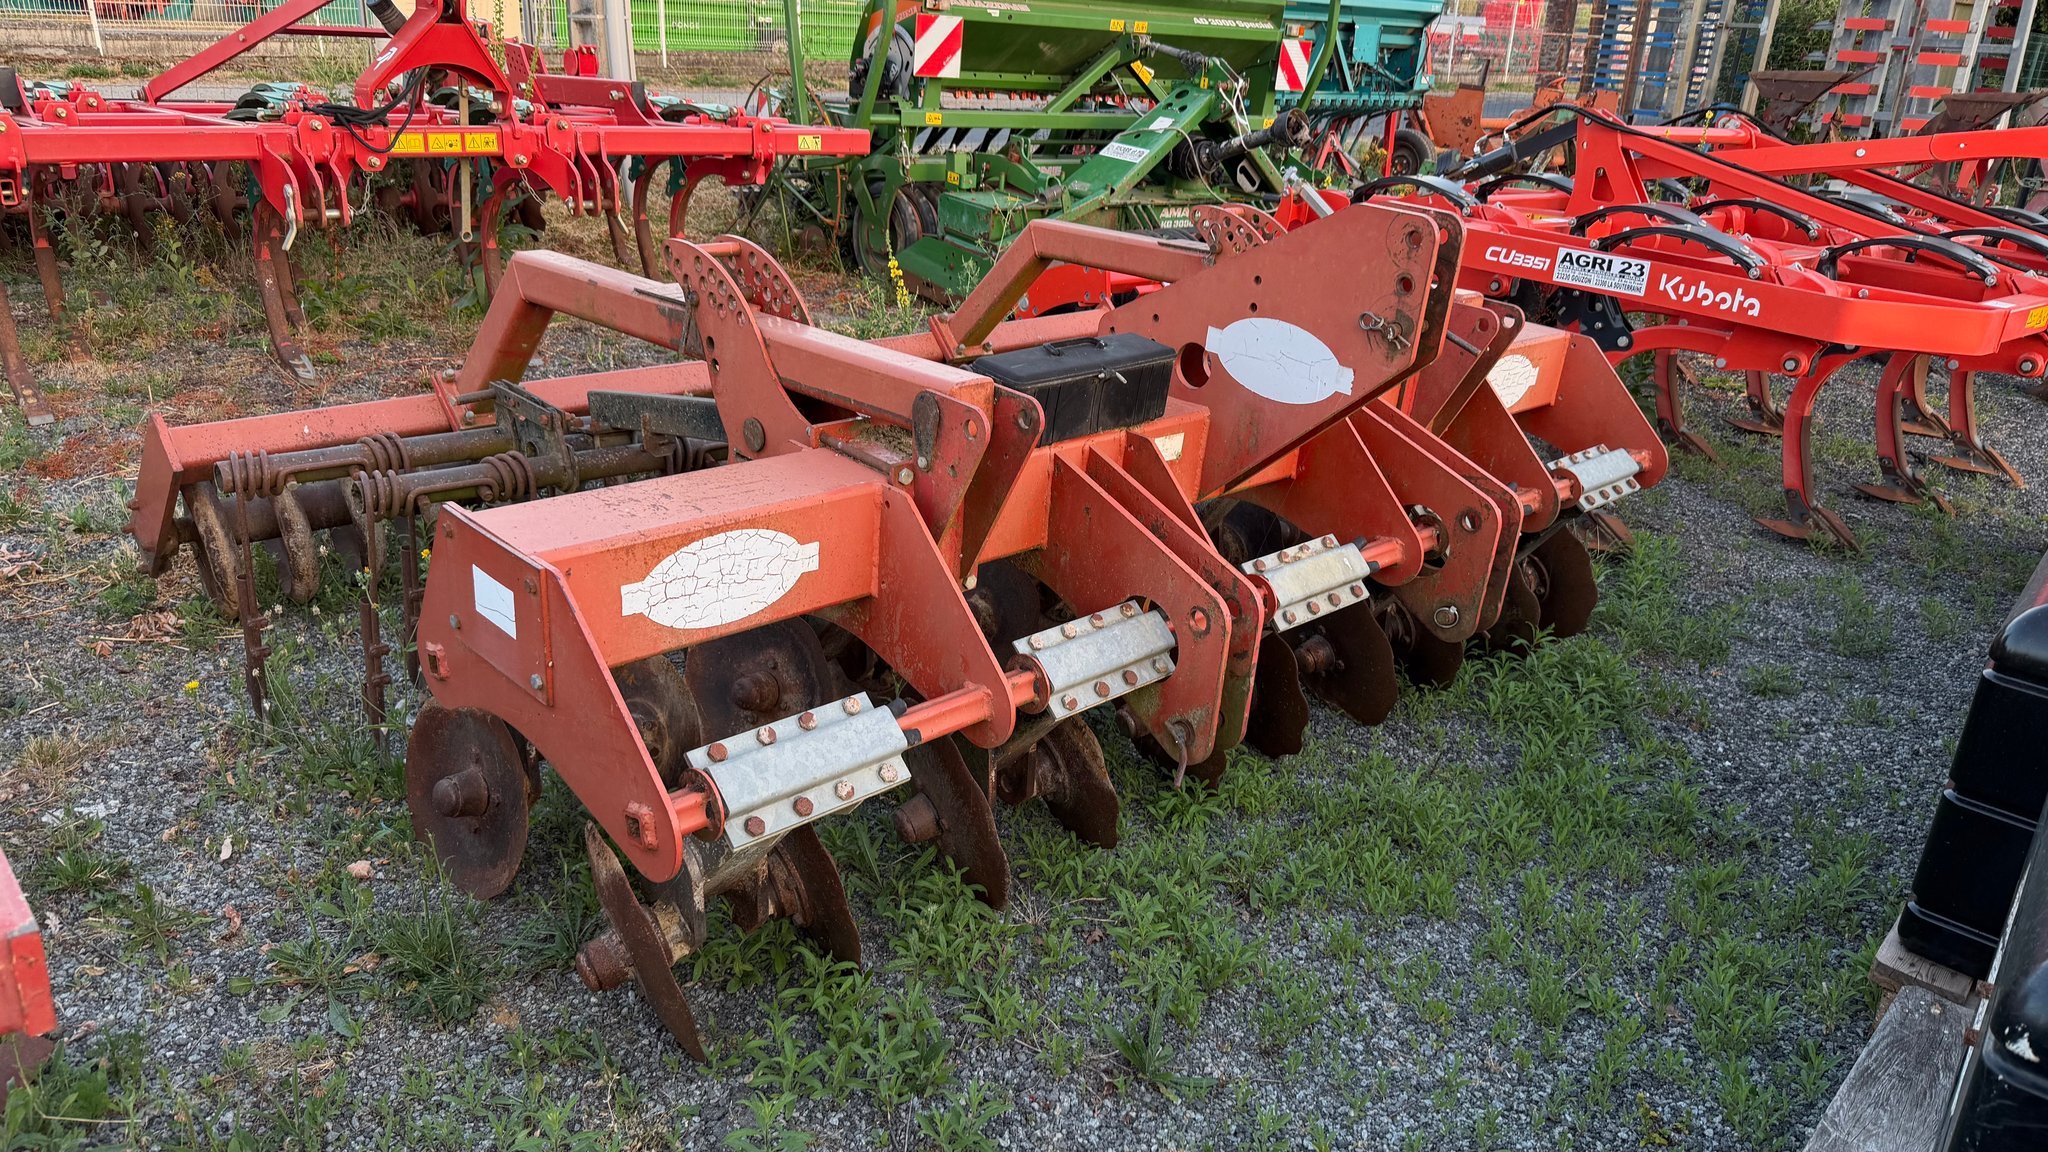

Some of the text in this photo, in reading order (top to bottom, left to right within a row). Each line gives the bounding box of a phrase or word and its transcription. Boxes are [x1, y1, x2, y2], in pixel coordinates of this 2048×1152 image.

[1193, 17, 1274, 29] AD 3000 Special
[1485, 246, 1551, 271] CU3351
[1560, 252, 1613, 272] AGRI
[1618, 261, 1645, 277] 23
[1659, 273, 1761, 317] Kubota
